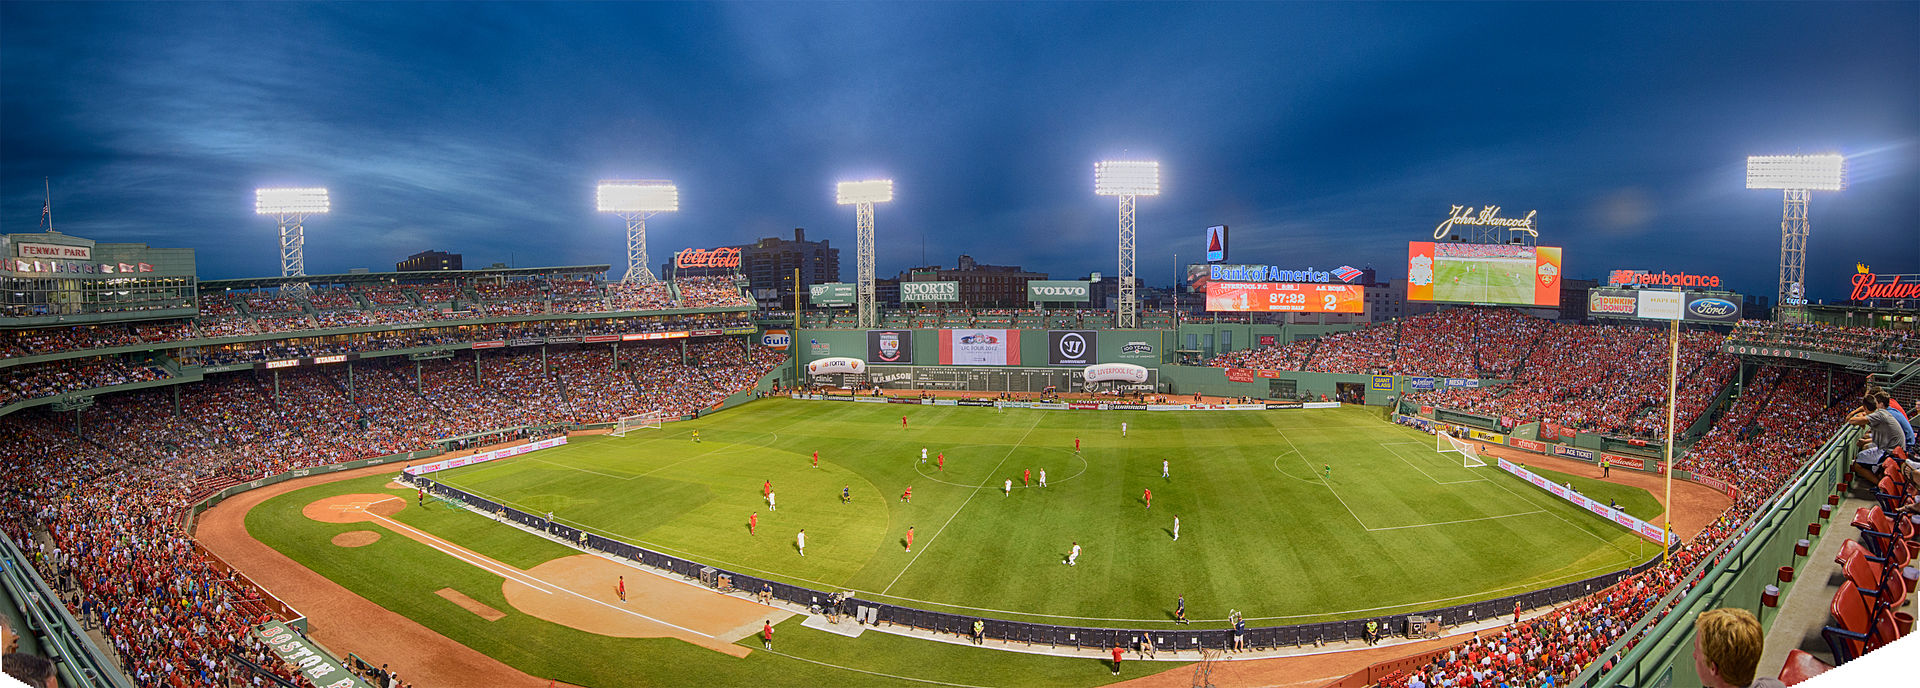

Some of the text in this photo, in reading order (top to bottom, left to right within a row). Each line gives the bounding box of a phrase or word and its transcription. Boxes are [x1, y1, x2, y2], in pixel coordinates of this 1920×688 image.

[1434, 204, 1539, 240] John Hancock
[23, 246, 87, 257] FENWAY PARK
[677, 247, 742, 269] Coca-Cola
[1210, 265, 1329, 283] Bank of America
[1662, 271, 1720, 287] balance
[903, 283, 955, 294] SPORTS
[1031, 286, 1086, 296] VOLVO
[1239, 293, 1250, 309] 1
[1269, 293, 1306, 304] 87:22
[1323, 294, 1337, 311] 2
[1603, 304, 1634, 313] DONUTS
[1697, 301, 1728, 315] Ford
[763, 335, 790, 345] Gulf
[267, 359, 298, 369] STANLEY
[316, 354, 346, 364] STANLEY
[1097, 367, 1125, 376] LIVERPOOL
[1477, 432, 1495, 441] Nikon
[1518, 440, 1538, 450] xfinity
[1566, 448, 1593, 459] ACE TICKET
[1602, 454, 1643, 468] Budweiser
[260, 625, 336, 679] BOSTON
